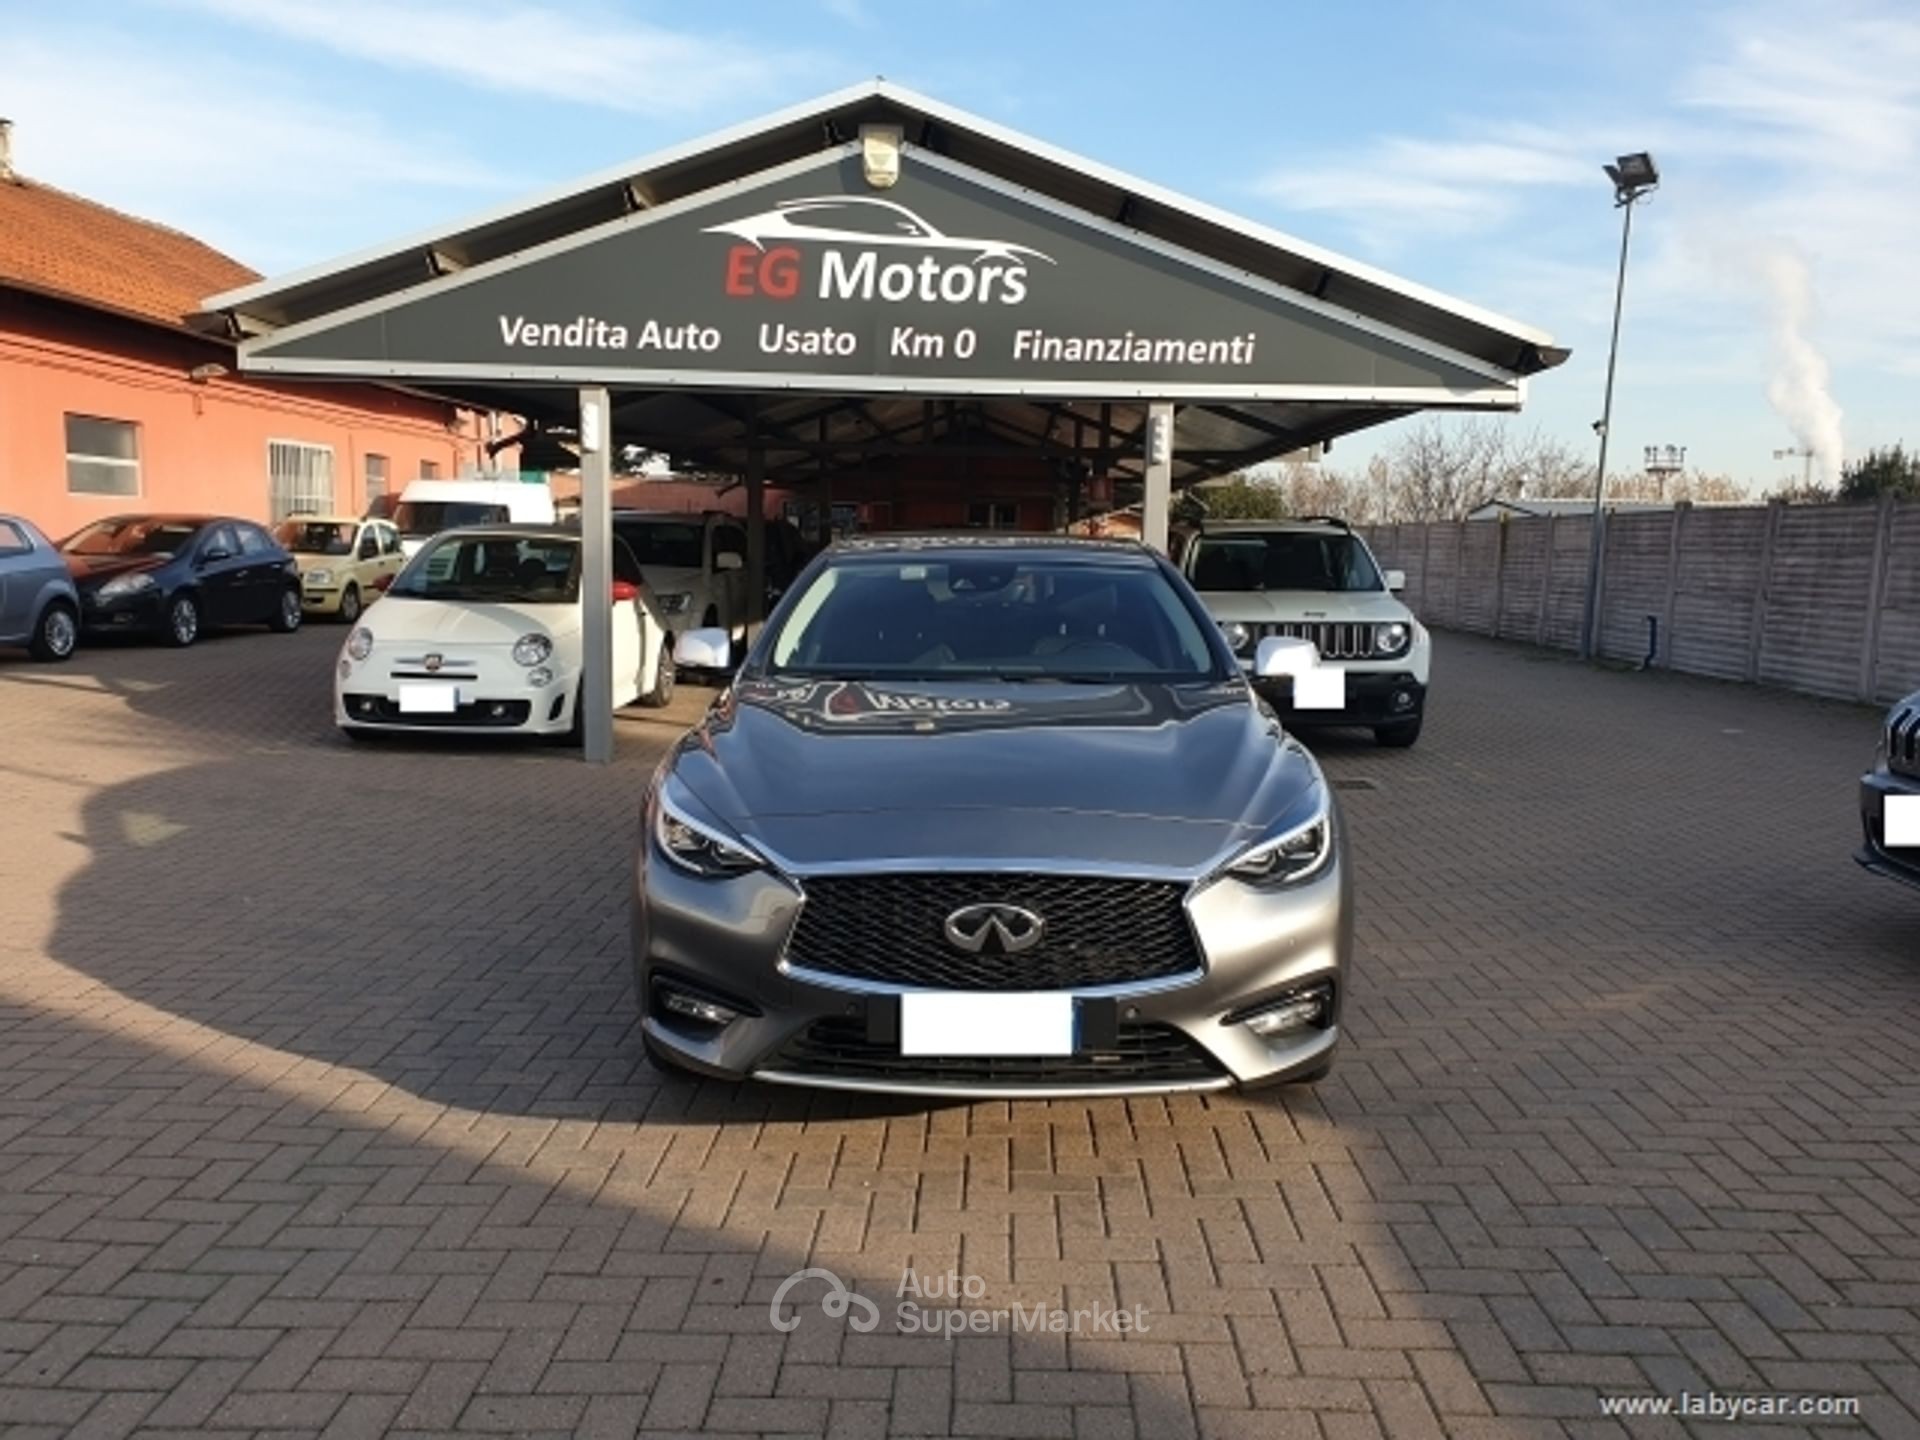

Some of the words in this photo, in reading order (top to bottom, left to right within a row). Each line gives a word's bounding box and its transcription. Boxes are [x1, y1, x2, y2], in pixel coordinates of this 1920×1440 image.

[725, 245, 800, 299] EG
[818, 249, 1028, 305] Motors
[499, 315, 629, 350] Vendita
[636, 318, 721, 352] Auto
[758, 322, 857, 356] Usato
[890, 325, 945, 358] Km
[953, 328, 977, 360] 0
[1013, 328, 1256, 366] Finanziamenti
